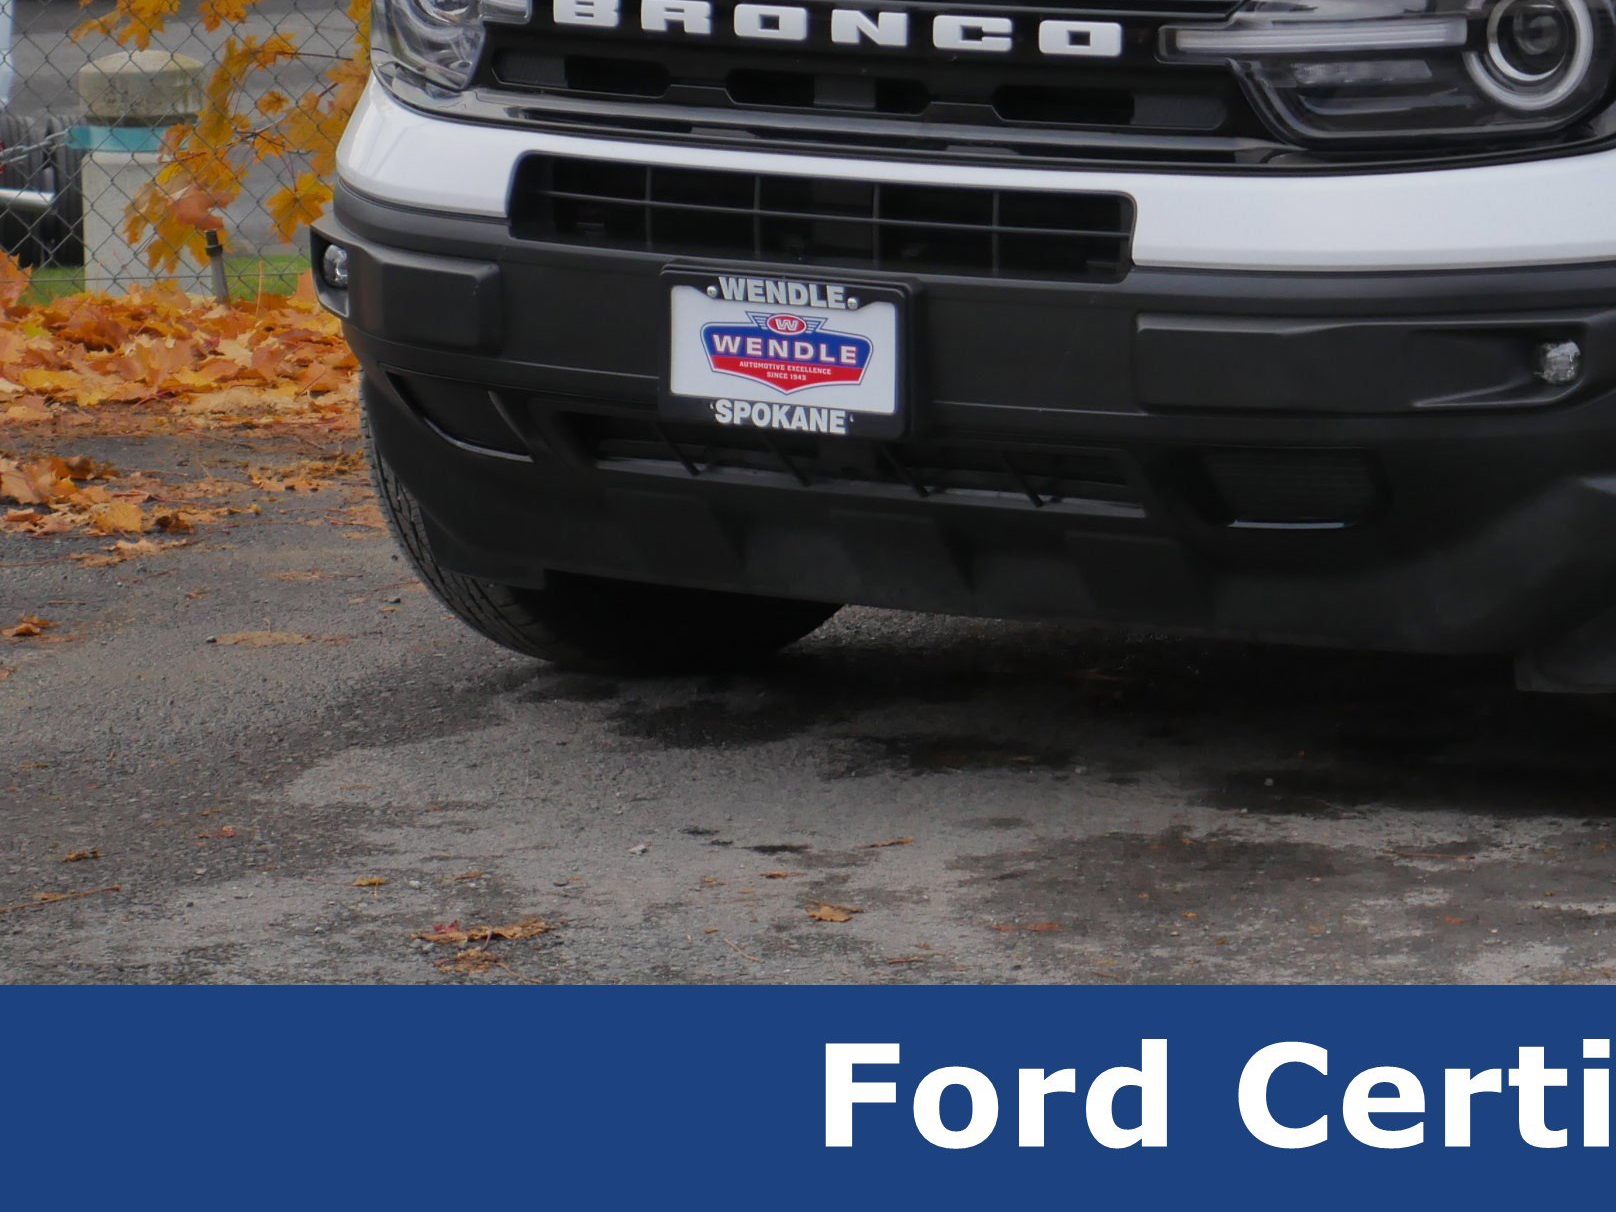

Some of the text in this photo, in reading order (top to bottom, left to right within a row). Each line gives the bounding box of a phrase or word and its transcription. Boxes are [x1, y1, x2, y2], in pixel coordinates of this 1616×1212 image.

[718, 276, 847, 310] WENDLE
[712, 334, 857, 365] WENDLE
[739, 361, 832, 376] AUTOMOTIVE EXCELLENCE
[766, 371, 807, 381] SINCE 1943
[714, 399, 847, 435] SPOKANE
